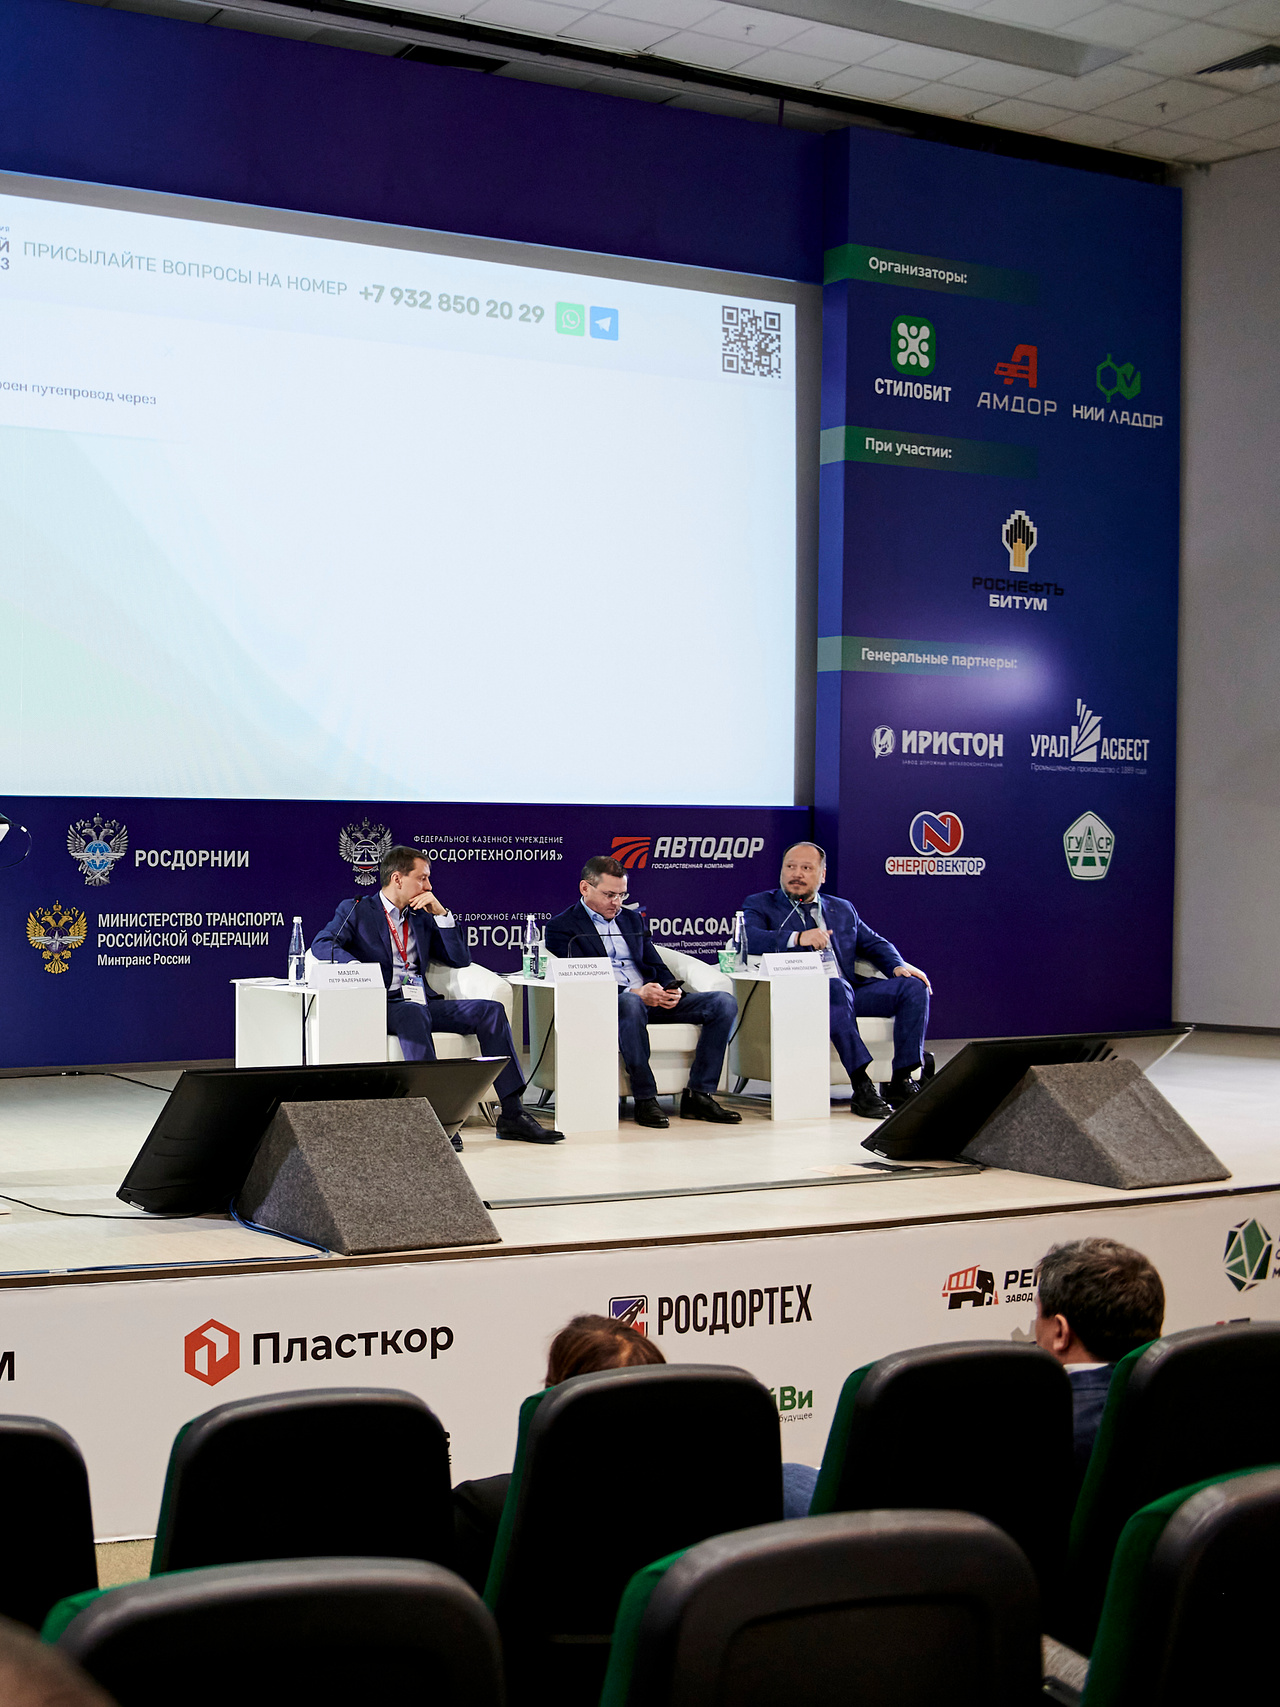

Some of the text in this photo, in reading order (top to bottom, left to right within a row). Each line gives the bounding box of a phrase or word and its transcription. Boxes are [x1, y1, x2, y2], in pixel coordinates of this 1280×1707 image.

[23, 241, 347, 295] ПРИСЫЛАЙТЕ ВОПРОСЫ НА НОМЕР
[868, 257, 968, 284] Организаторы:
[359, 284, 545, 324] +7 932 850 20 29
[31, 382, 115, 402] путепровод
[117, 392, 157, 406] через
[874, 377, 952, 403] СТИЛОБИТ
[976, 391, 1058, 417] АМДОР
[1072, 404, 1164, 429] НИИ ЛАДОР
[864, 437, 953, 459] При участии:
[971, 576, 1065, 597] РОСНЕФТЬ
[989, 594, 1048, 611] БИТУМ
[861, 647, 1018, 671] Генеральные партнеры:
[901, 729, 1004, 759] ИРИСТОН
[1030, 734, 1150, 761] УРАЛ АСБЕСТ
[413, 835, 563, 844] ФЕДЕРАЛЬНОЕ КАЗЕННОЕ УЧРЕЖДЕНИЕ
[653, 836, 765, 860] АВТОДОР
[134, 849, 250, 871] РОСДОРНИИ
[887, 858, 984, 874] ЭНЕРГОВЕКТОР
[98, 912, 285, 928] МИНИСТЕРСТВО ТРАНСПОРТА
[465, 913, 508, 921] ДОРОЖНОЕ
[511, 912, 552, 920] АГЕНСТВО
[649, 917, 737, 936] РОСАСФАЛ
[97, 930, 269, 948] РОССИЙСКОЙ ФЕДЕРАЦИИ
[681, 940, 723, 948] Производителей
[97, 953, 191, 968] Минтранс России
[657, 1283, 813, 1336] РОСДОРТЕХ
[1005, 1292, 1034, 1304] ЗАВОД
[252, 1325, 454, 1366] Пласткор
